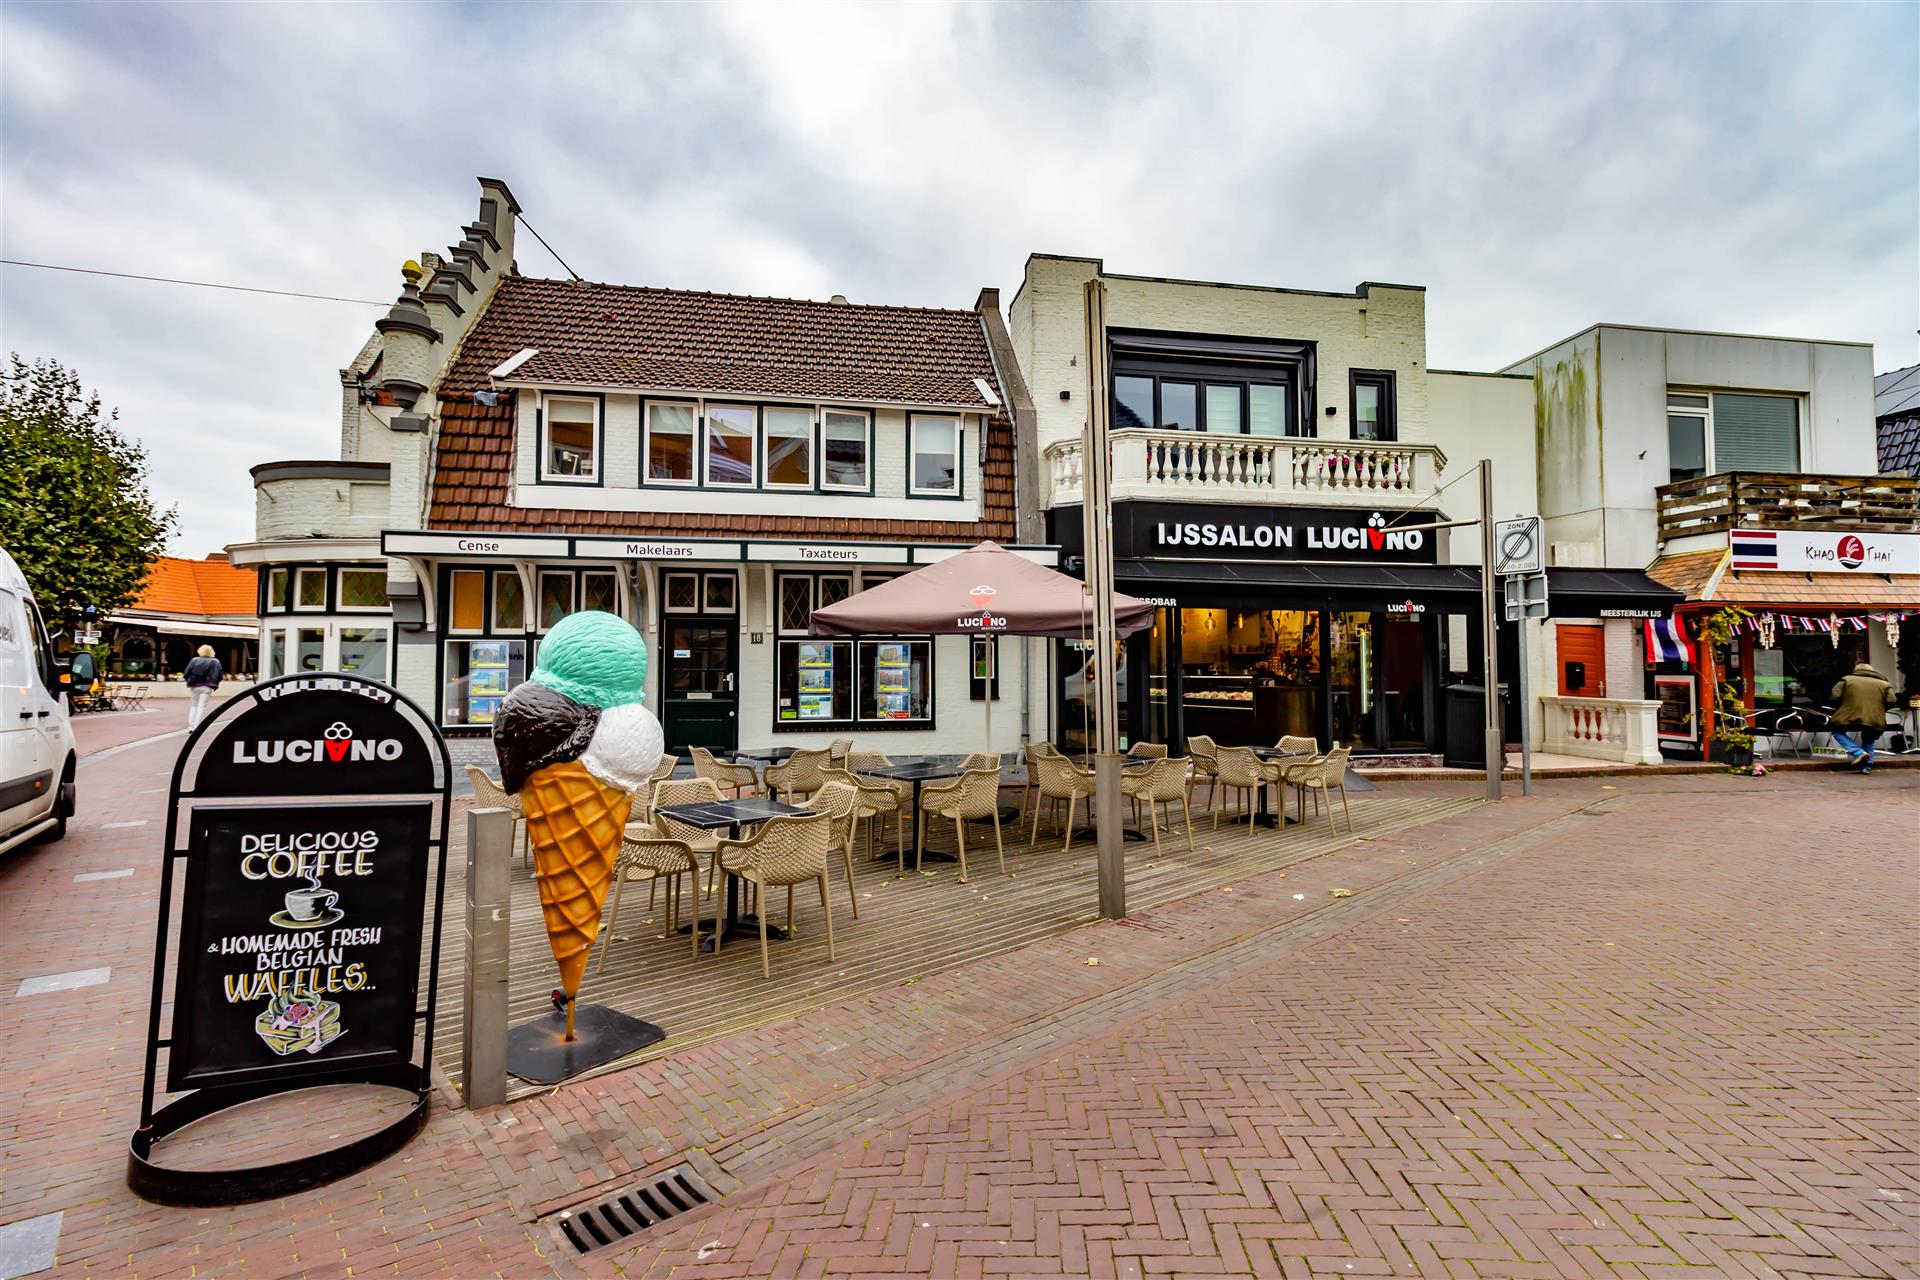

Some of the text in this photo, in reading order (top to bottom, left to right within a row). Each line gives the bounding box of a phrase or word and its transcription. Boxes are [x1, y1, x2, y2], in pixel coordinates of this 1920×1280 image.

[1507, 522, 1526, 530] ZONE
[1158, 523, 1293, 548] IJSSALON
[458, 540, 499, 551] Cense
[626, 544, 693, 556] Makelaars
[799, 547, 858, 559] Taxateurs
[1600, 609, 1662, 618] MEESTERLIJK IJS
[241, 831, 379, 853] DELICIOUS
[241, 849, 376, 880] COFFEE
[207, 927, 382, 955] & HOMEMADE FRESH
[256, 947, 344, 971] BELGIAN
